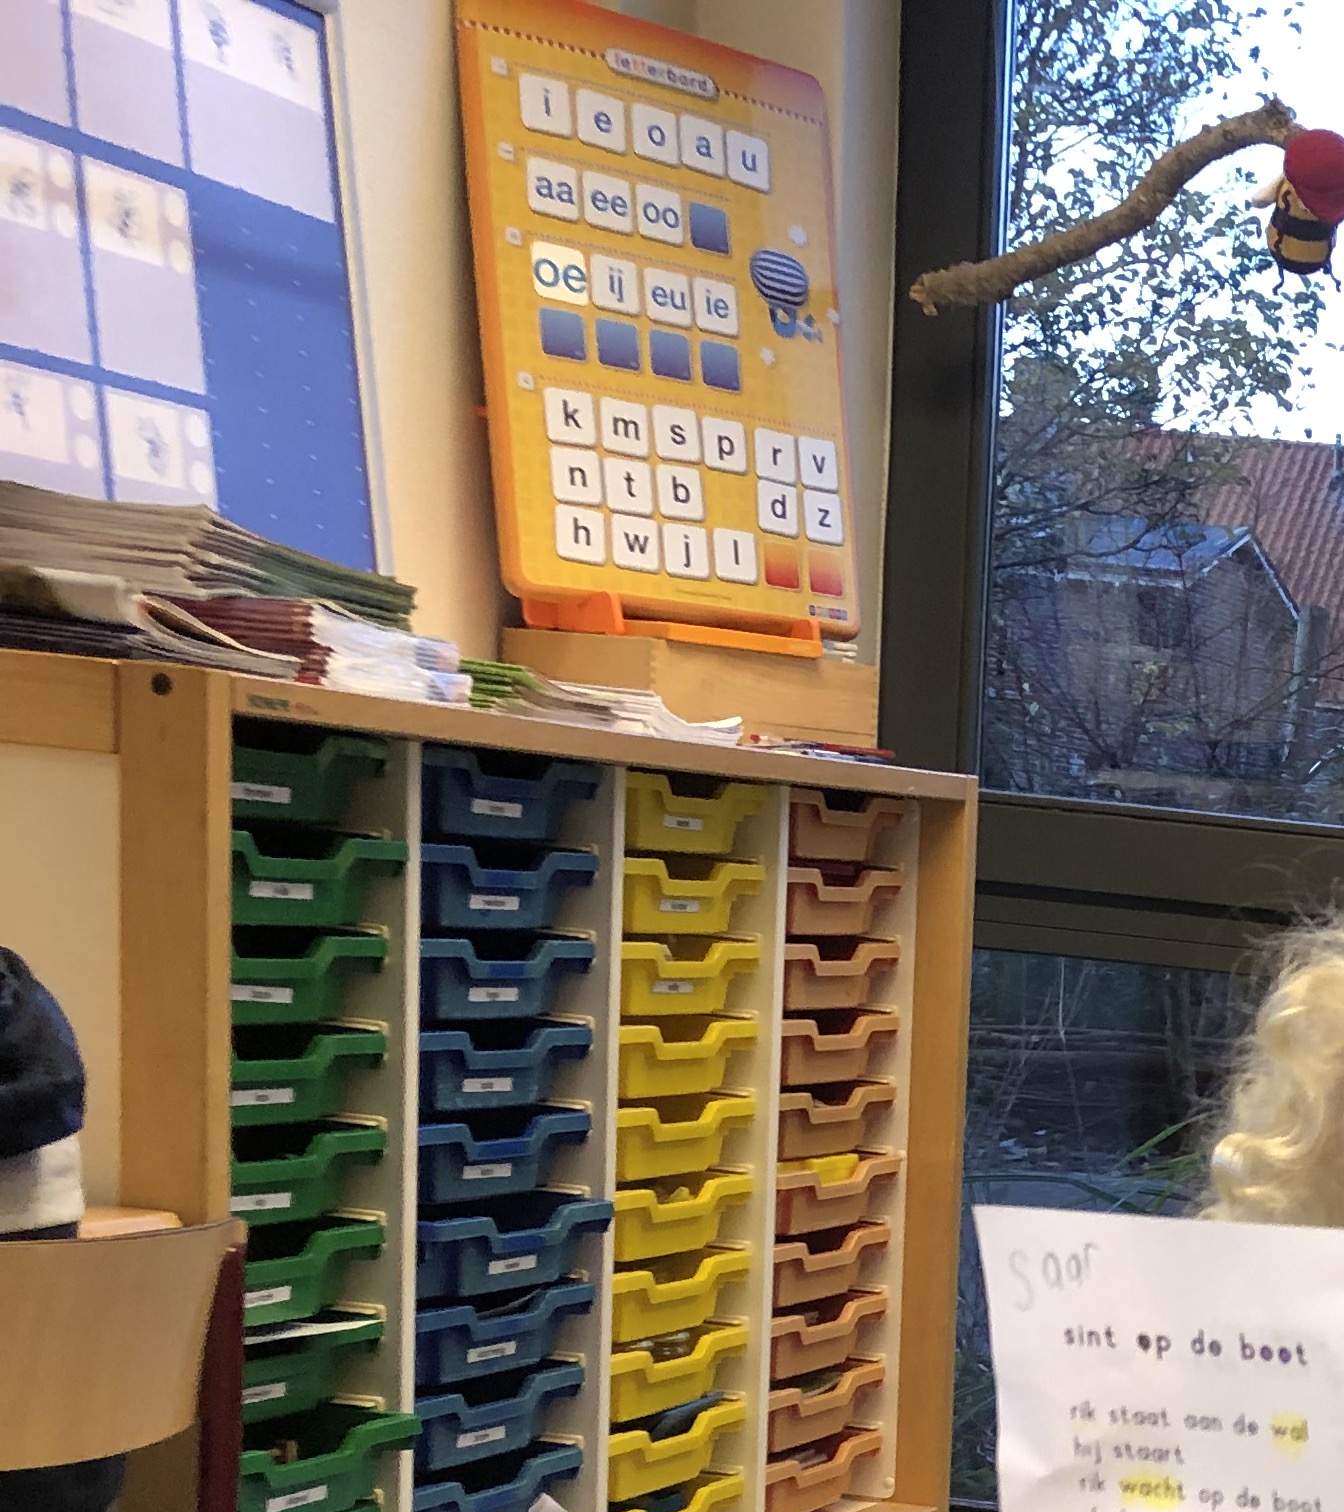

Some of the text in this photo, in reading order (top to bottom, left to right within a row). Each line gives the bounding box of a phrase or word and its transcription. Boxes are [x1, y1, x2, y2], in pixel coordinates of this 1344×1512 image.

[544, 88, 757, 172] i e o a u
[536, 176, 679, 228] aa ee oo
[533, 260, 730, 318] oe ij eu ie
[562, 399, 825, 474] k m s p r v
[569, 466, 831, 528] n t b d z
[573, 517, 739, 568] h w j l
[1063, 1324, 1309, 1368] sint op de boot
[1108, 1405, 1171, 1429] staat
[1183, 1413, 1223, 1432] aan
[1232, 1412, 1260, 1437] de
[1270, 1419, 1310, 1443] wal
[1119, 1476, 1187, 1501] wacht
[1197, 1488, 1225, 1512] op
[1234, 1486, 1262, 1511] de
